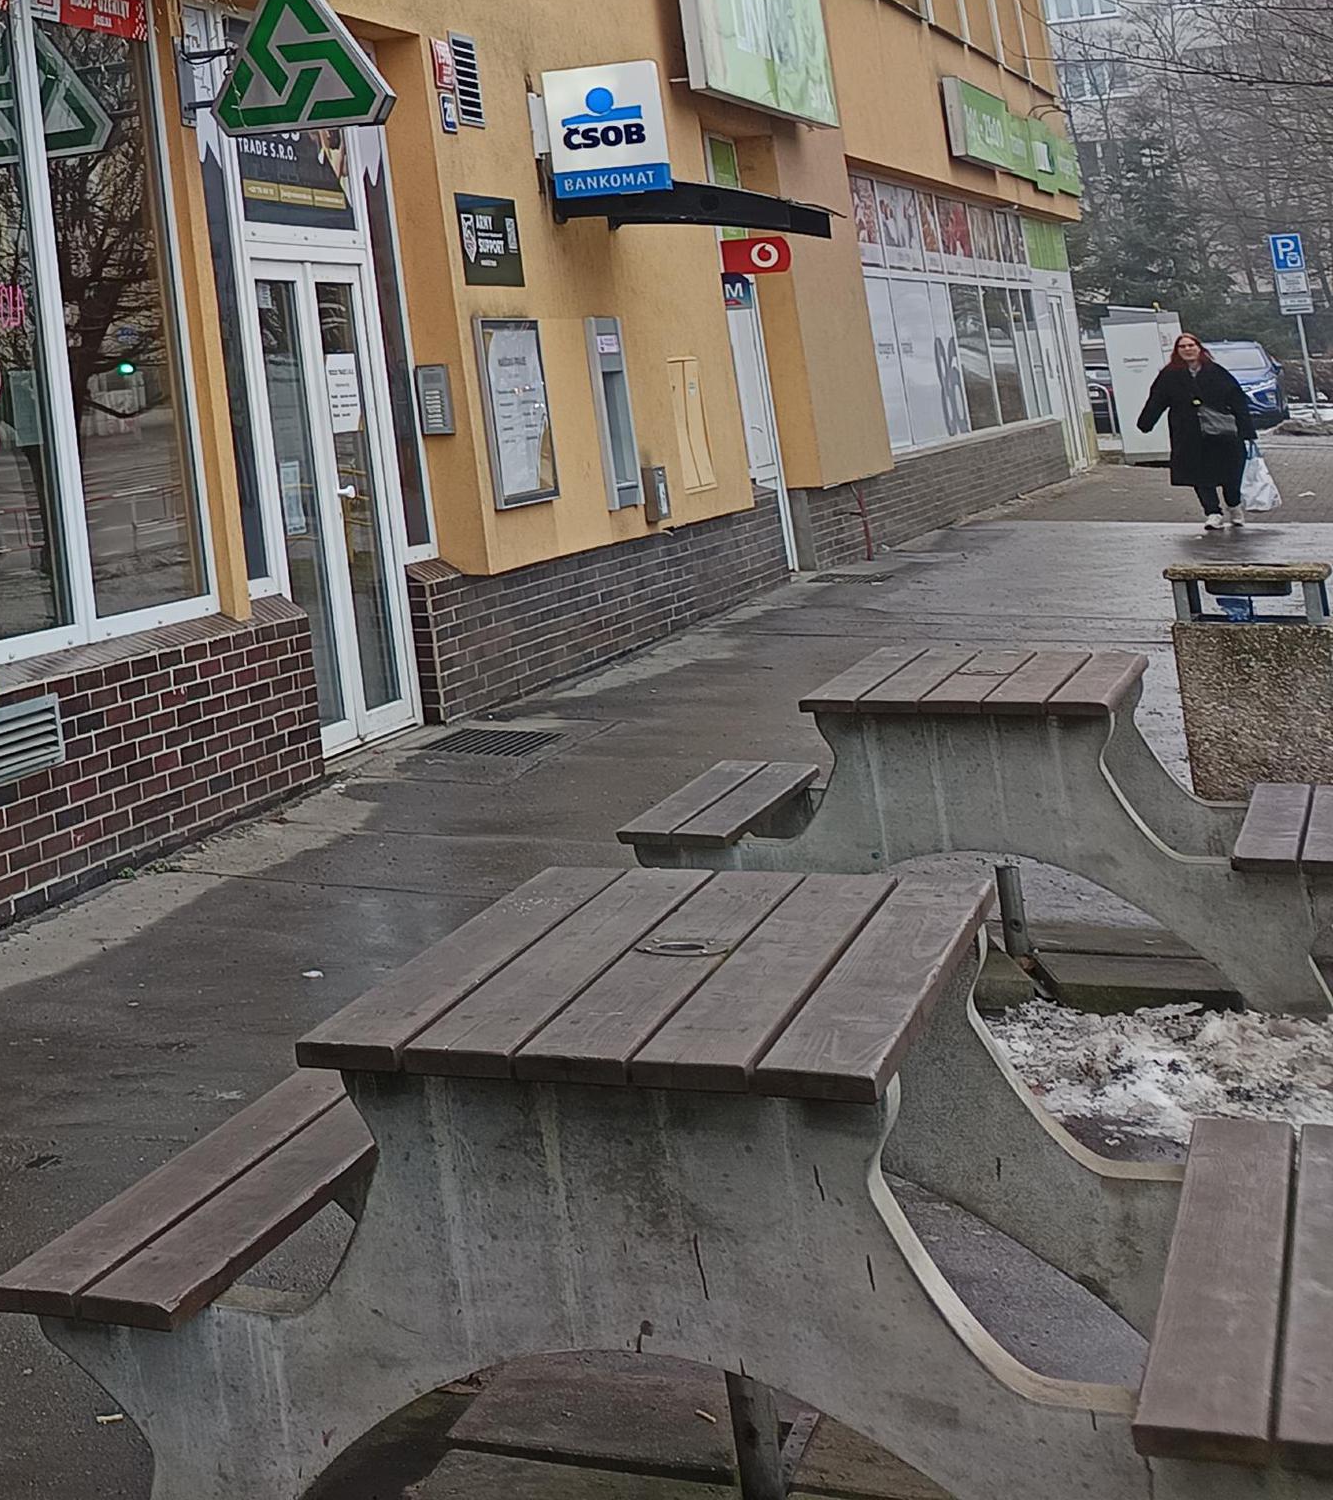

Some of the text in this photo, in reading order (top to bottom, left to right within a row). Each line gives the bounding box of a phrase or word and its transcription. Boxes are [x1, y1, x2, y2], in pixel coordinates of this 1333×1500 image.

[563, 123, 646, 150] ČSOB
[238, 138, 298, 161] TRADE S.R.O.
[564, 171, 655, 192] BANKOMAT
[1276, 239, 1295, 260] P
